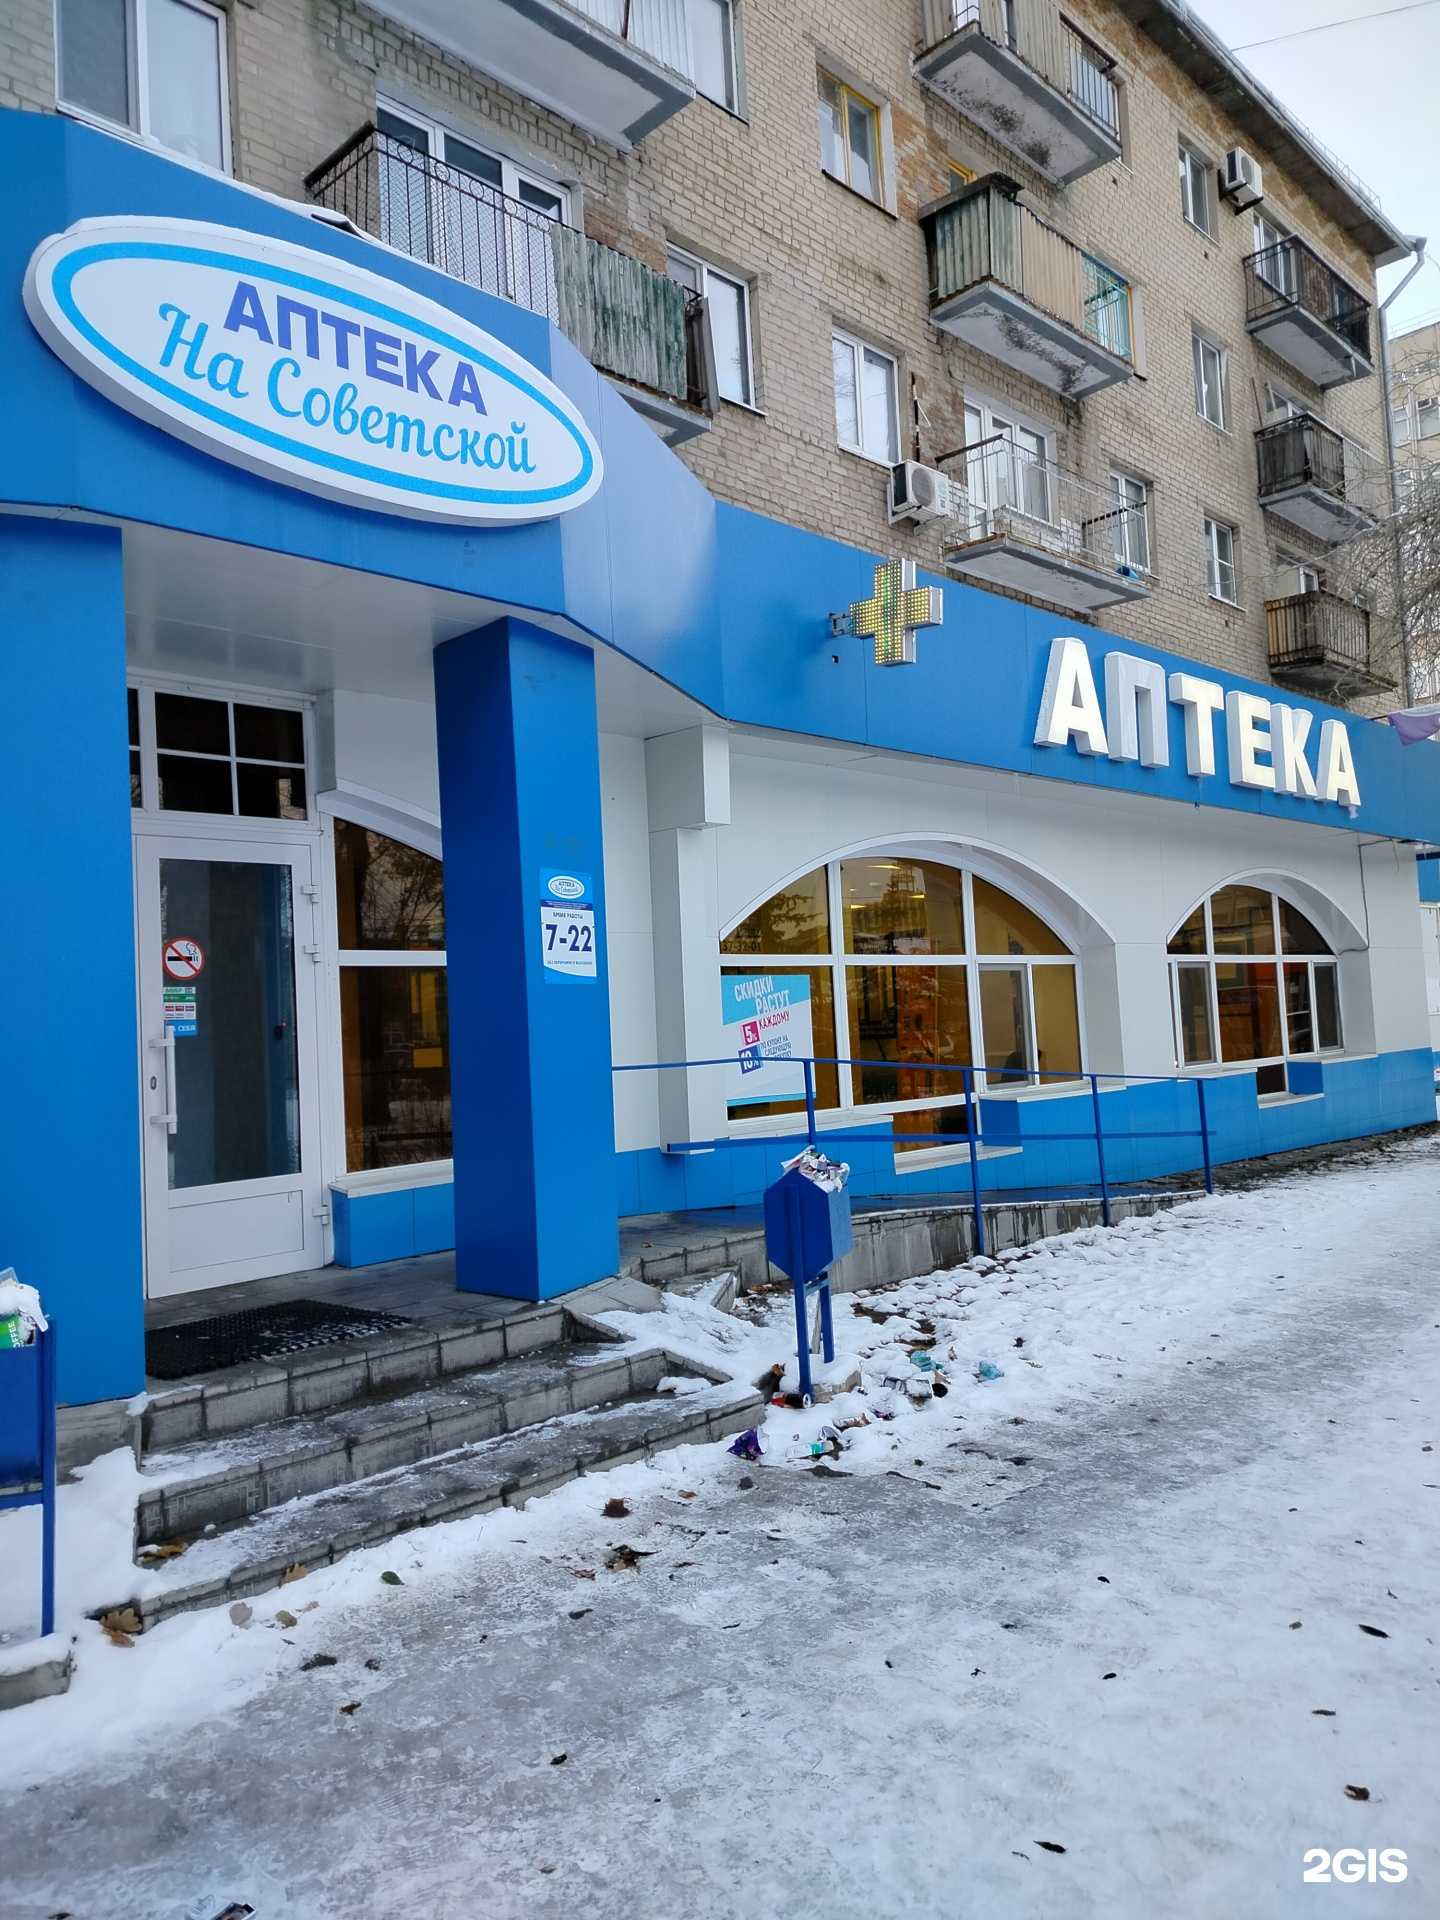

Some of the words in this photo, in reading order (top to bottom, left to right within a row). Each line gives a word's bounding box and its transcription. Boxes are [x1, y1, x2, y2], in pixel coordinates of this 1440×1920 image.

[223, 281, 488, 416] АПТЕКА
[158, 303, 249, 399] На
[266, 357, 537, 474] Советской
[1033, 636, 1361, 807] АПТЕКА
[545, 923, 592, 952] 7-22
[735, 976, 774, 1002] СКИДКИ
[755, 990, 790, 1014] РАСТУТ
[759, 1011, 790, 1030] КАЖДОМУ
